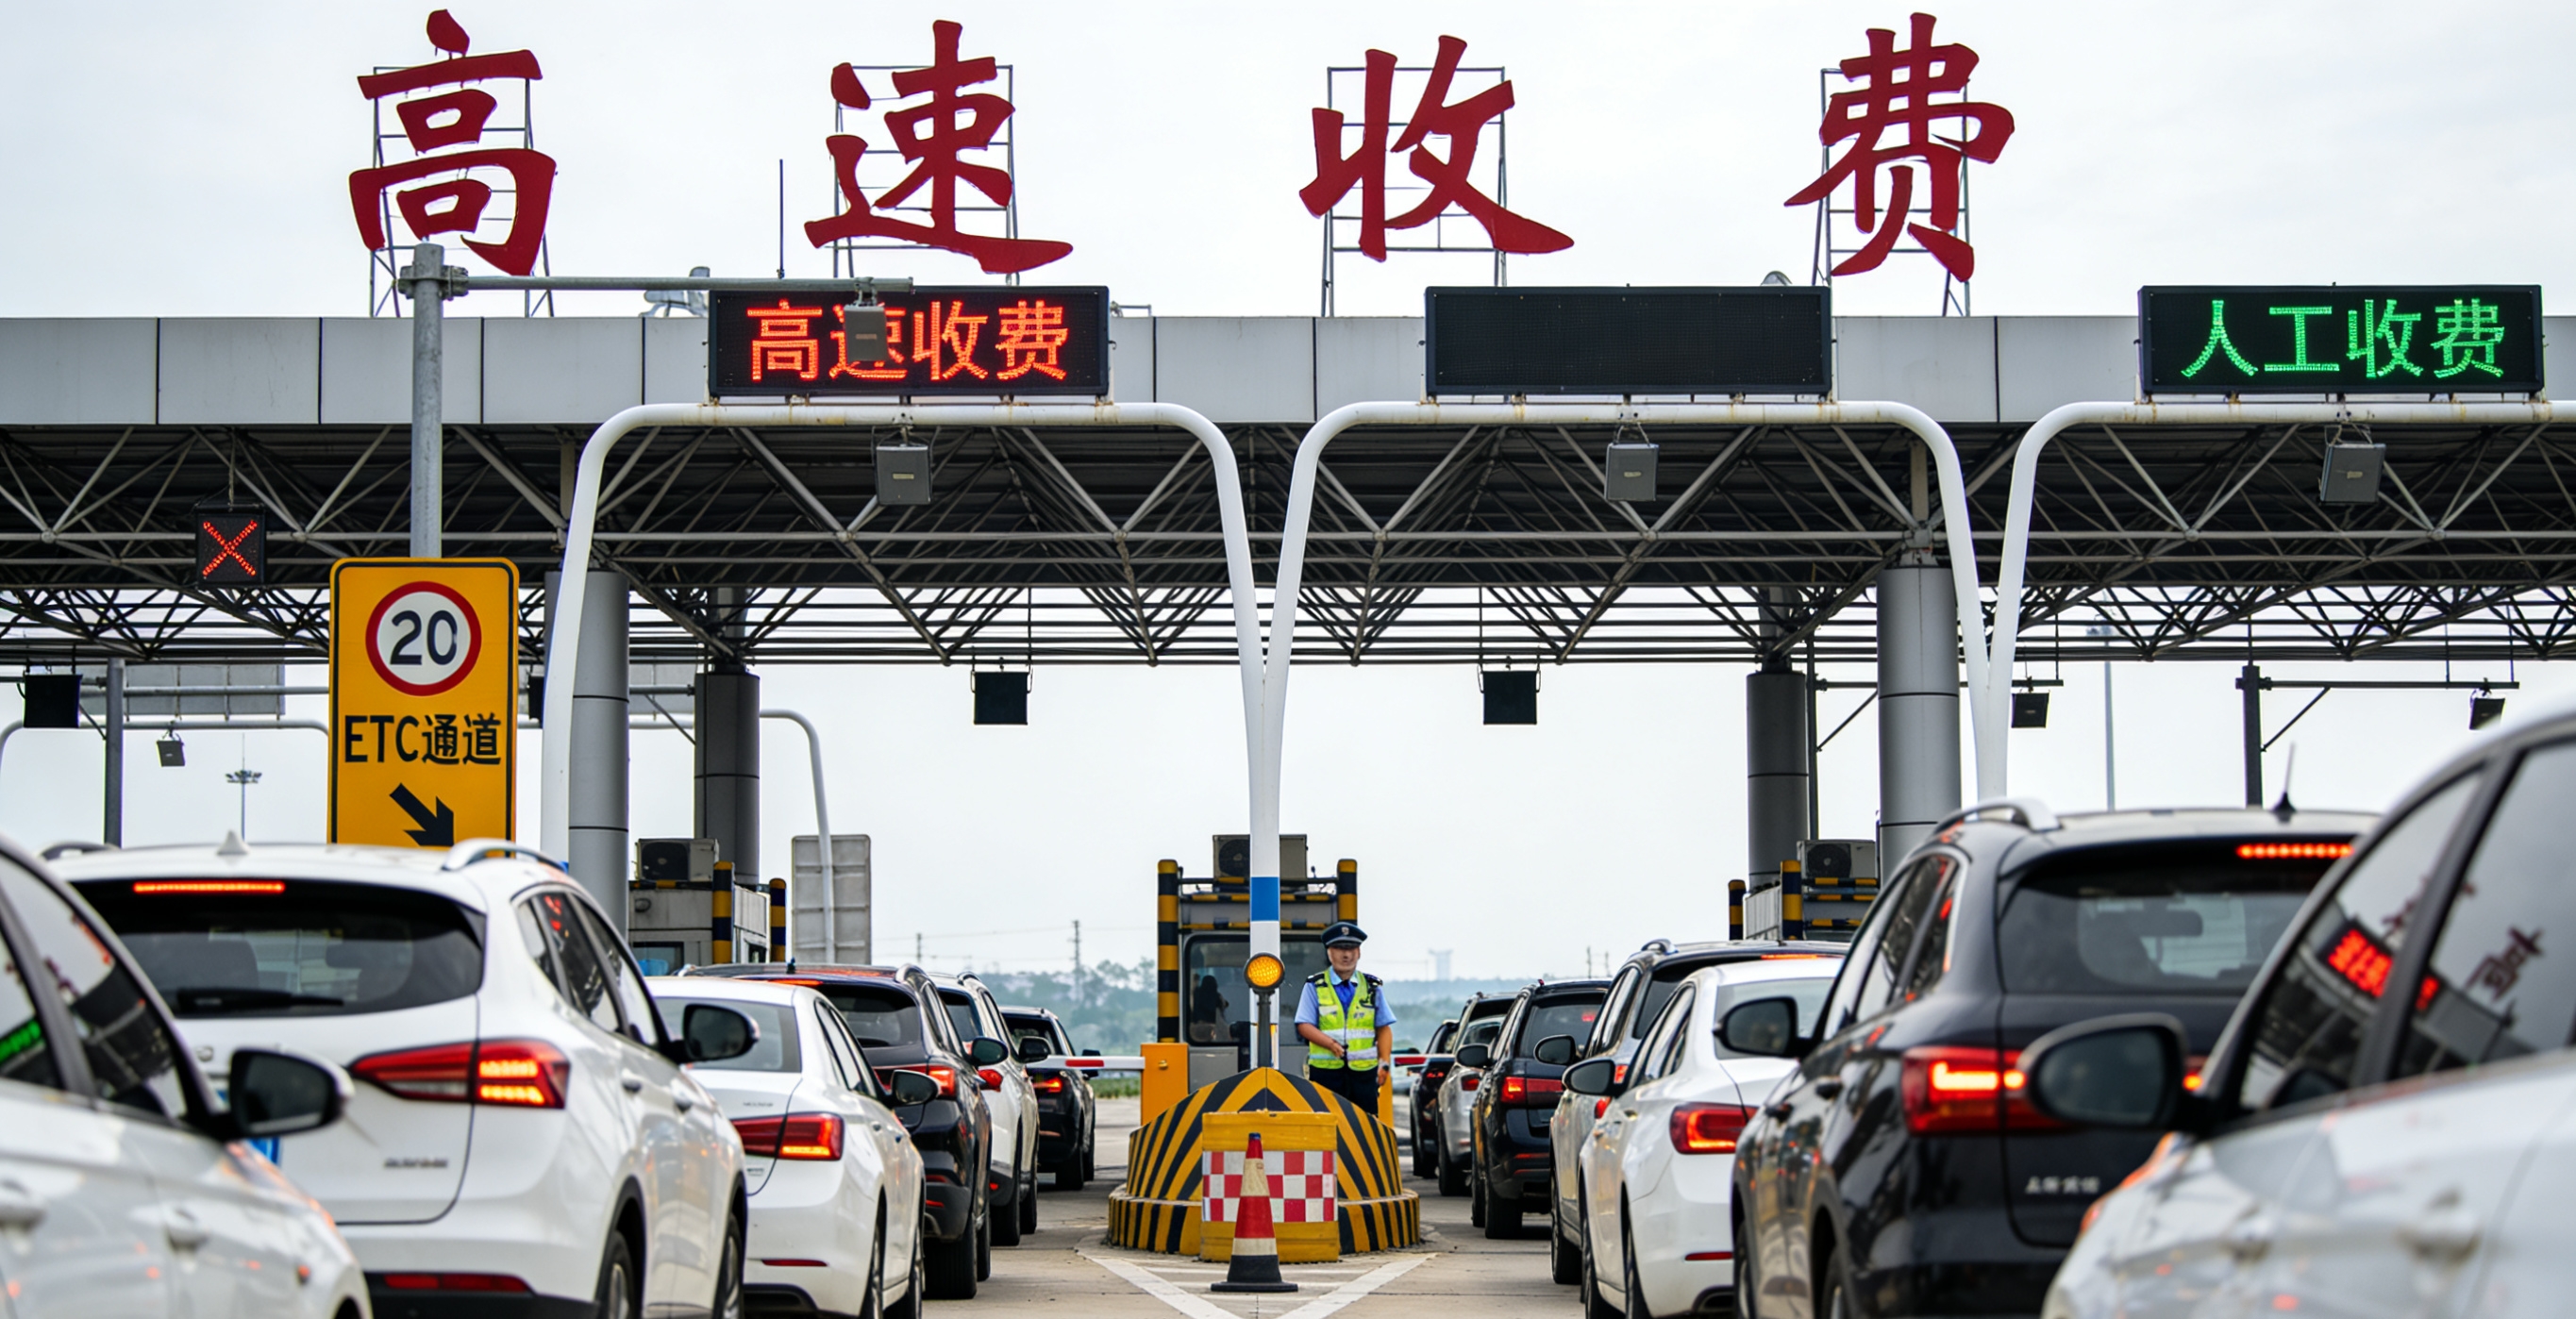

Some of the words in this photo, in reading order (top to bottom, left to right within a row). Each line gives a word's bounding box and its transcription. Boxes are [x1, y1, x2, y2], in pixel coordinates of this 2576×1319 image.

[349, 9, 2016, 282] 高速收费
[2181, 299, 2506, 379] 人工收费
[390, 609, 459, 666] 20
[344, 712, 502, 766] ETC通道
